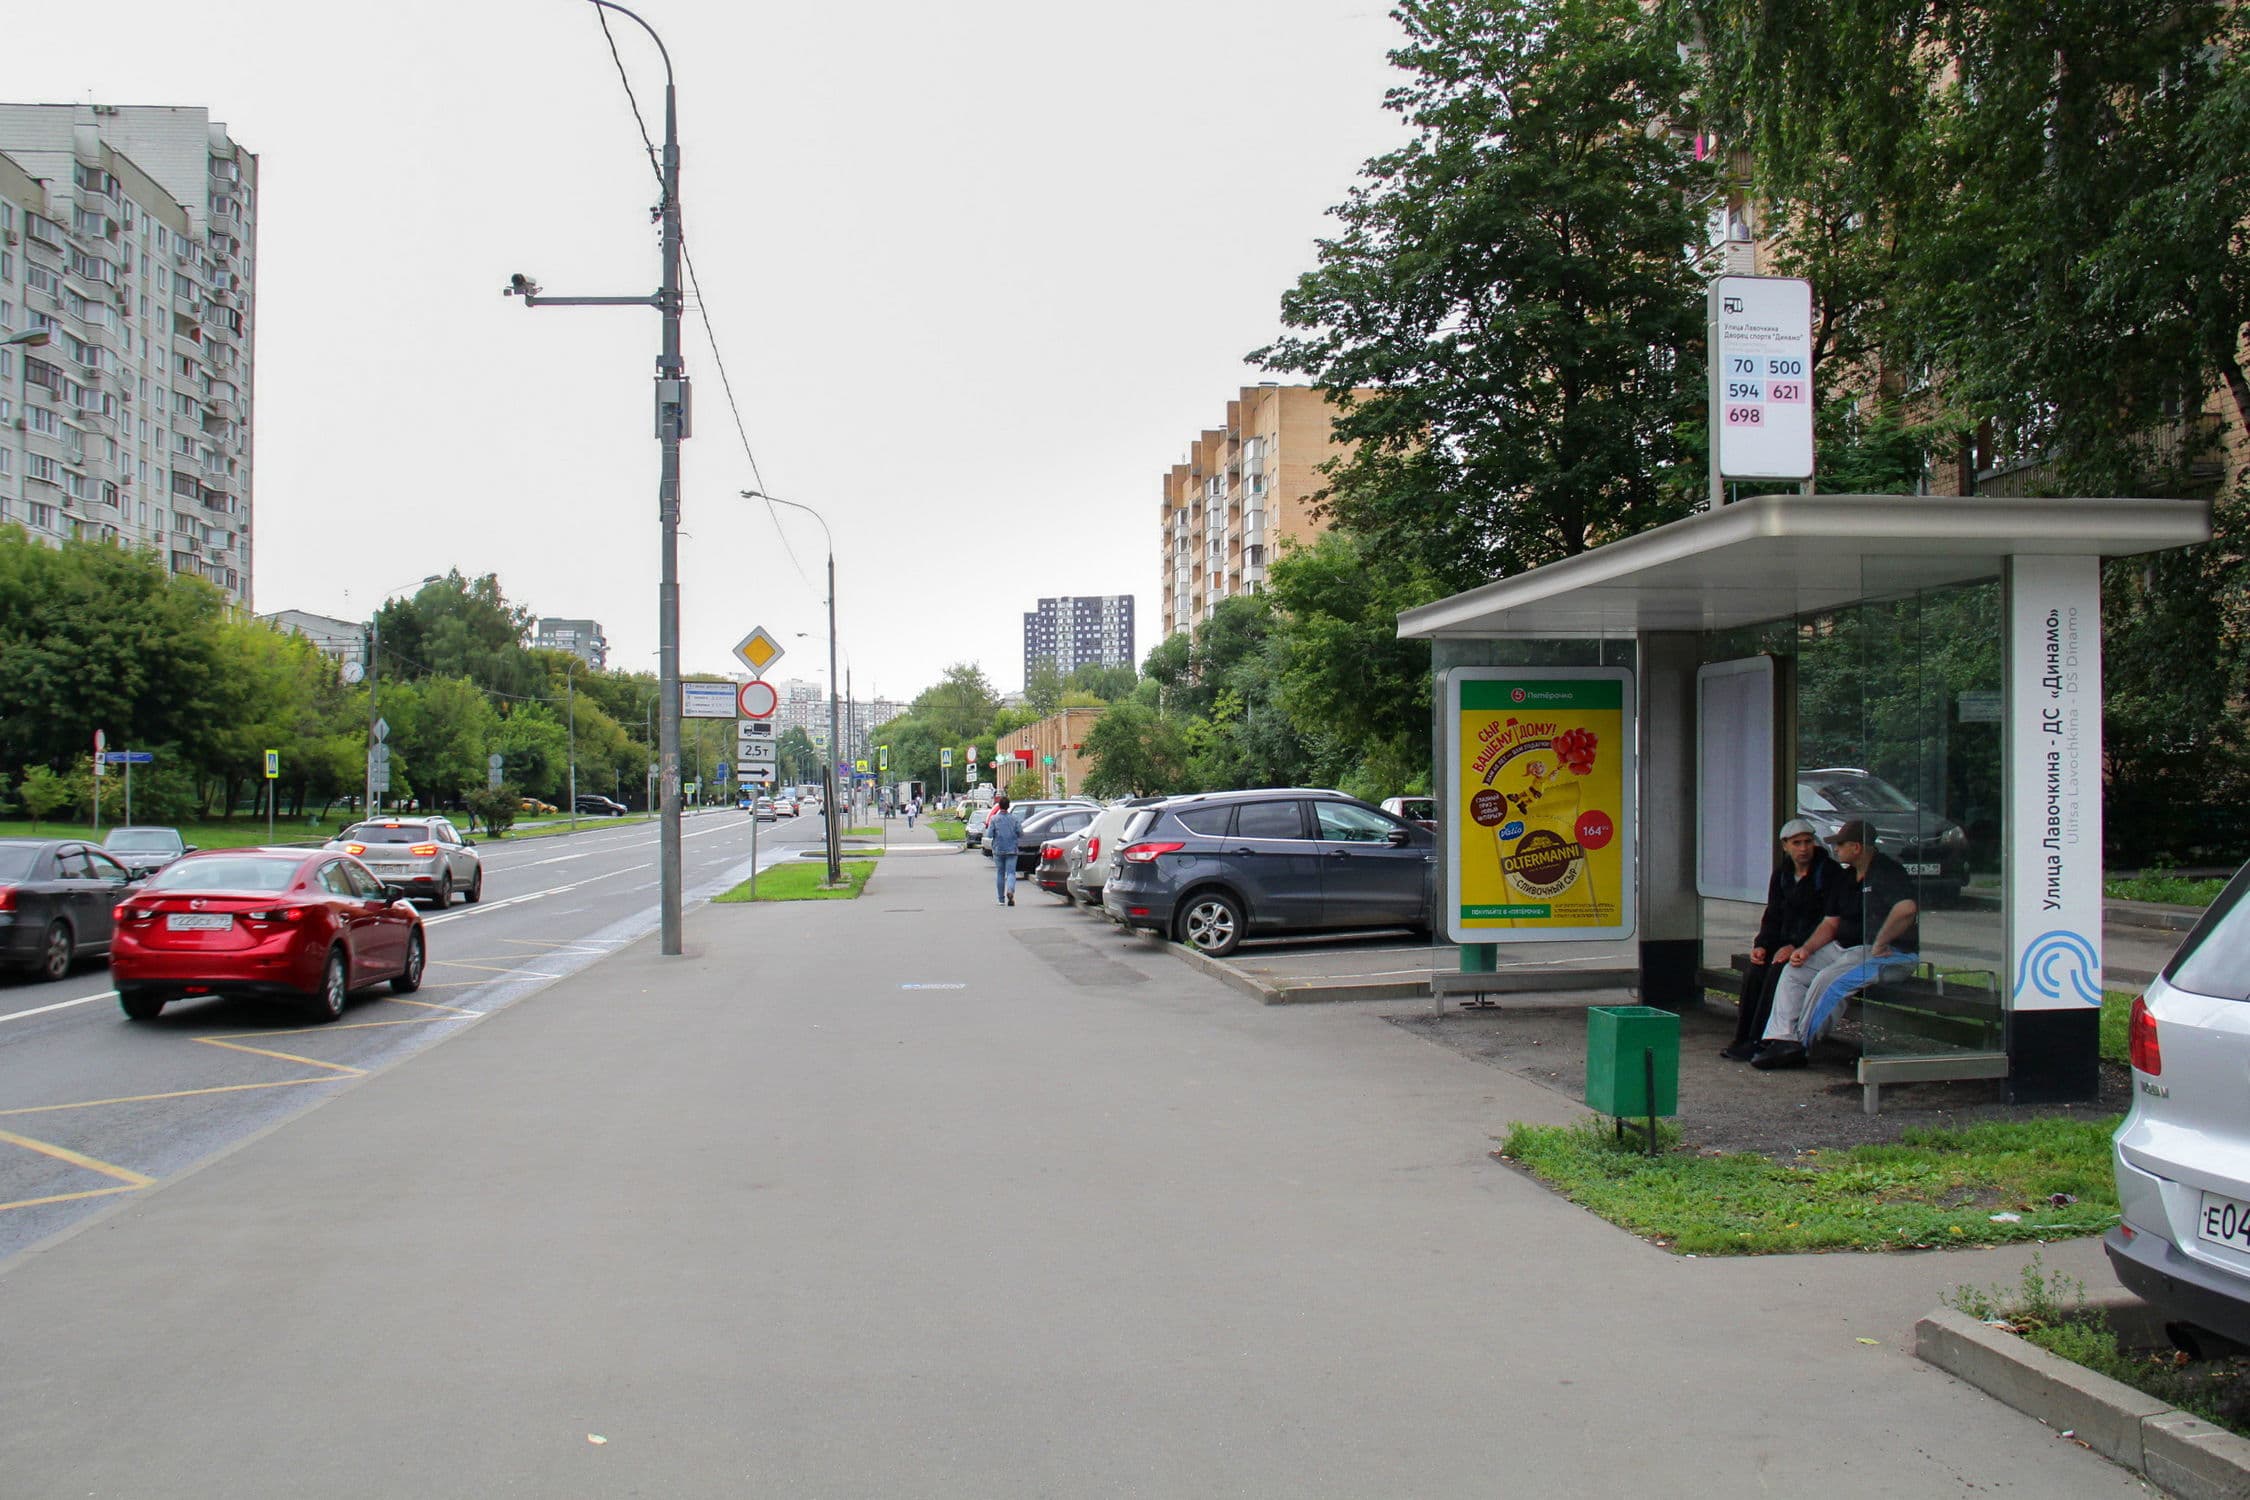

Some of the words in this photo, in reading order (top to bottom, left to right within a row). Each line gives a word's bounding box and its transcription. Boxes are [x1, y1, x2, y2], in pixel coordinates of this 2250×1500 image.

[1724, 332, 1748, 340] Дворец
[1744, 324, 1779, 332] Лавочкина
[1734, 359, 1754, 373] 70
[1769, 361, 1801, 375] 500
[1729, 384, 1759, 398] 594
[1773, 385, 1799, 400] 621
[1729, 408, 1760, 423] 698
[2066, 607, 2079, 667] Dinamo
[2042, 608, 2062, 699] «Динамо»
[2066, 672, 2079, 694] DS
[1478, 721, 1500, 742] СЫР
[2042, 708, 2062, 735] ДС
[1472, 729, 1512, 773] ВАШЕМУ
[1520, 723, 1557, 739] ДОМУ!
[2066, 709, 2079, 796] Lavochkina
[2042, 751, 2062, 851] Лавочкина
[1501, 827, 1522, 837] Valio
[1583, 826, 1601, 836] 164
[2065, 801, 2079, 845] Ulitsa
[1504, 844, 1580, 871] OLTERMANNI
[1516, 880, 1565, 896] СЛИВОЧНЫЙ
[1566, 868, 1578, 884] СЫР
[2042, 855, 2062, 911] Улица
